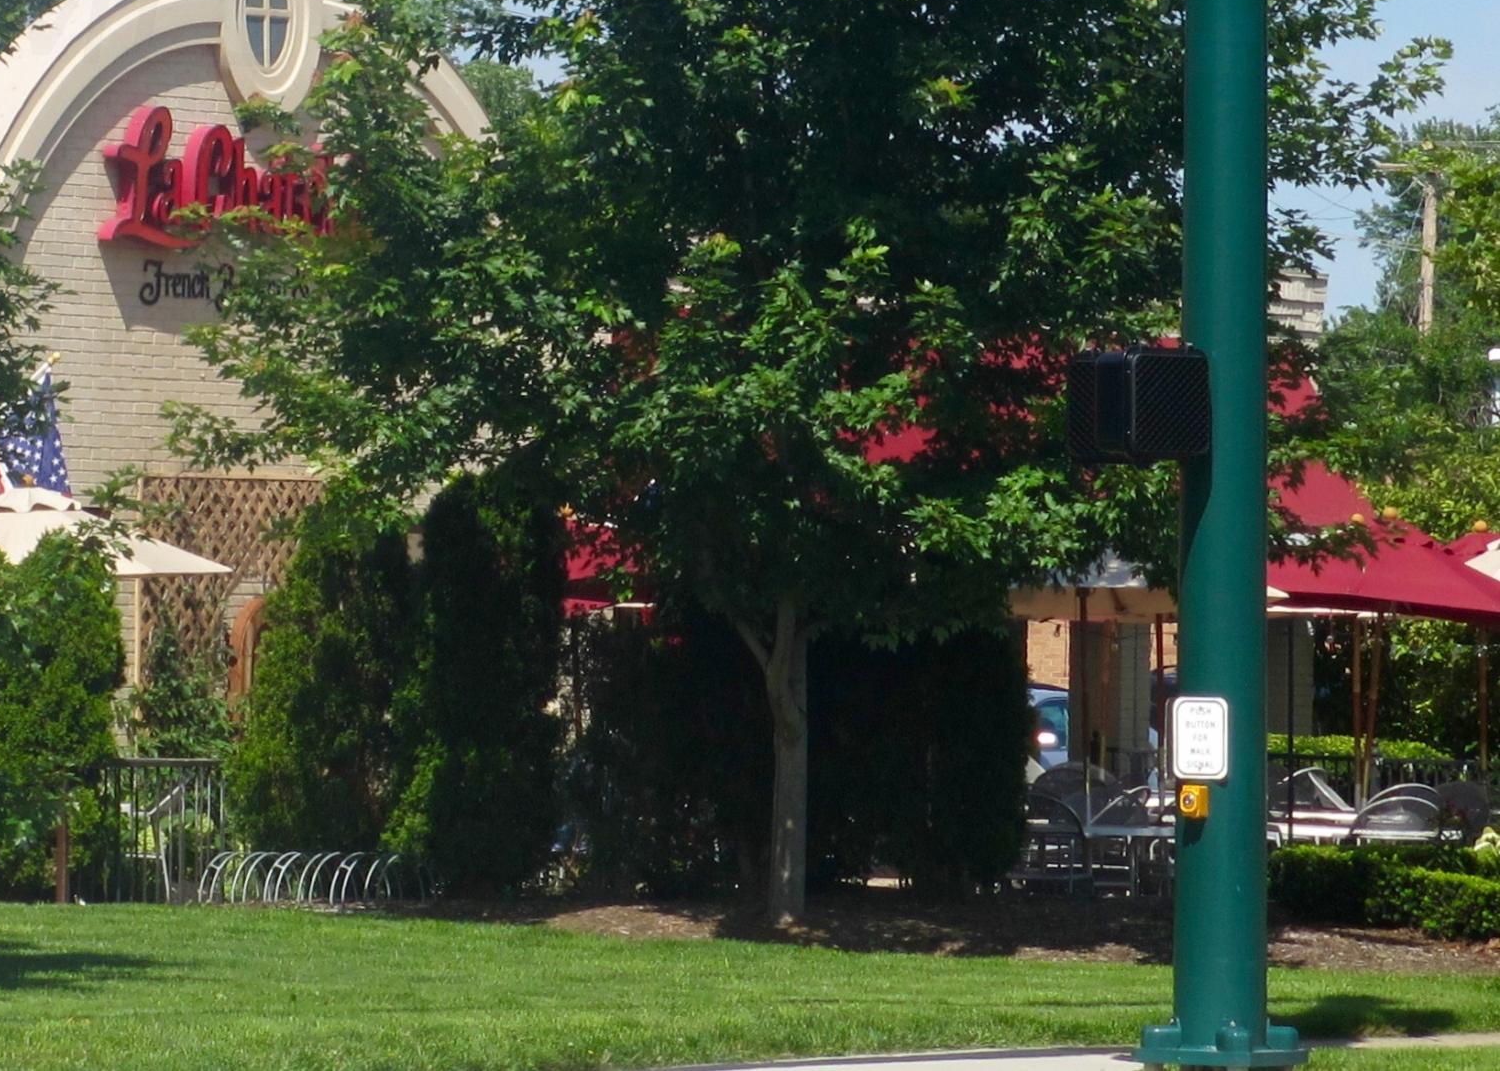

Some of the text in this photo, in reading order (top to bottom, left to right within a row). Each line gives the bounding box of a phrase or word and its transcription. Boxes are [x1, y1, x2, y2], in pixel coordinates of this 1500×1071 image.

[97, 105, 204, 249] La
[139, 259, 211, 306] French
[1190, 706, 1211, 715] PUSH
[1186, 720, 1215, 729] BUTTON
[1192, 734, 1208, 742] FOR
